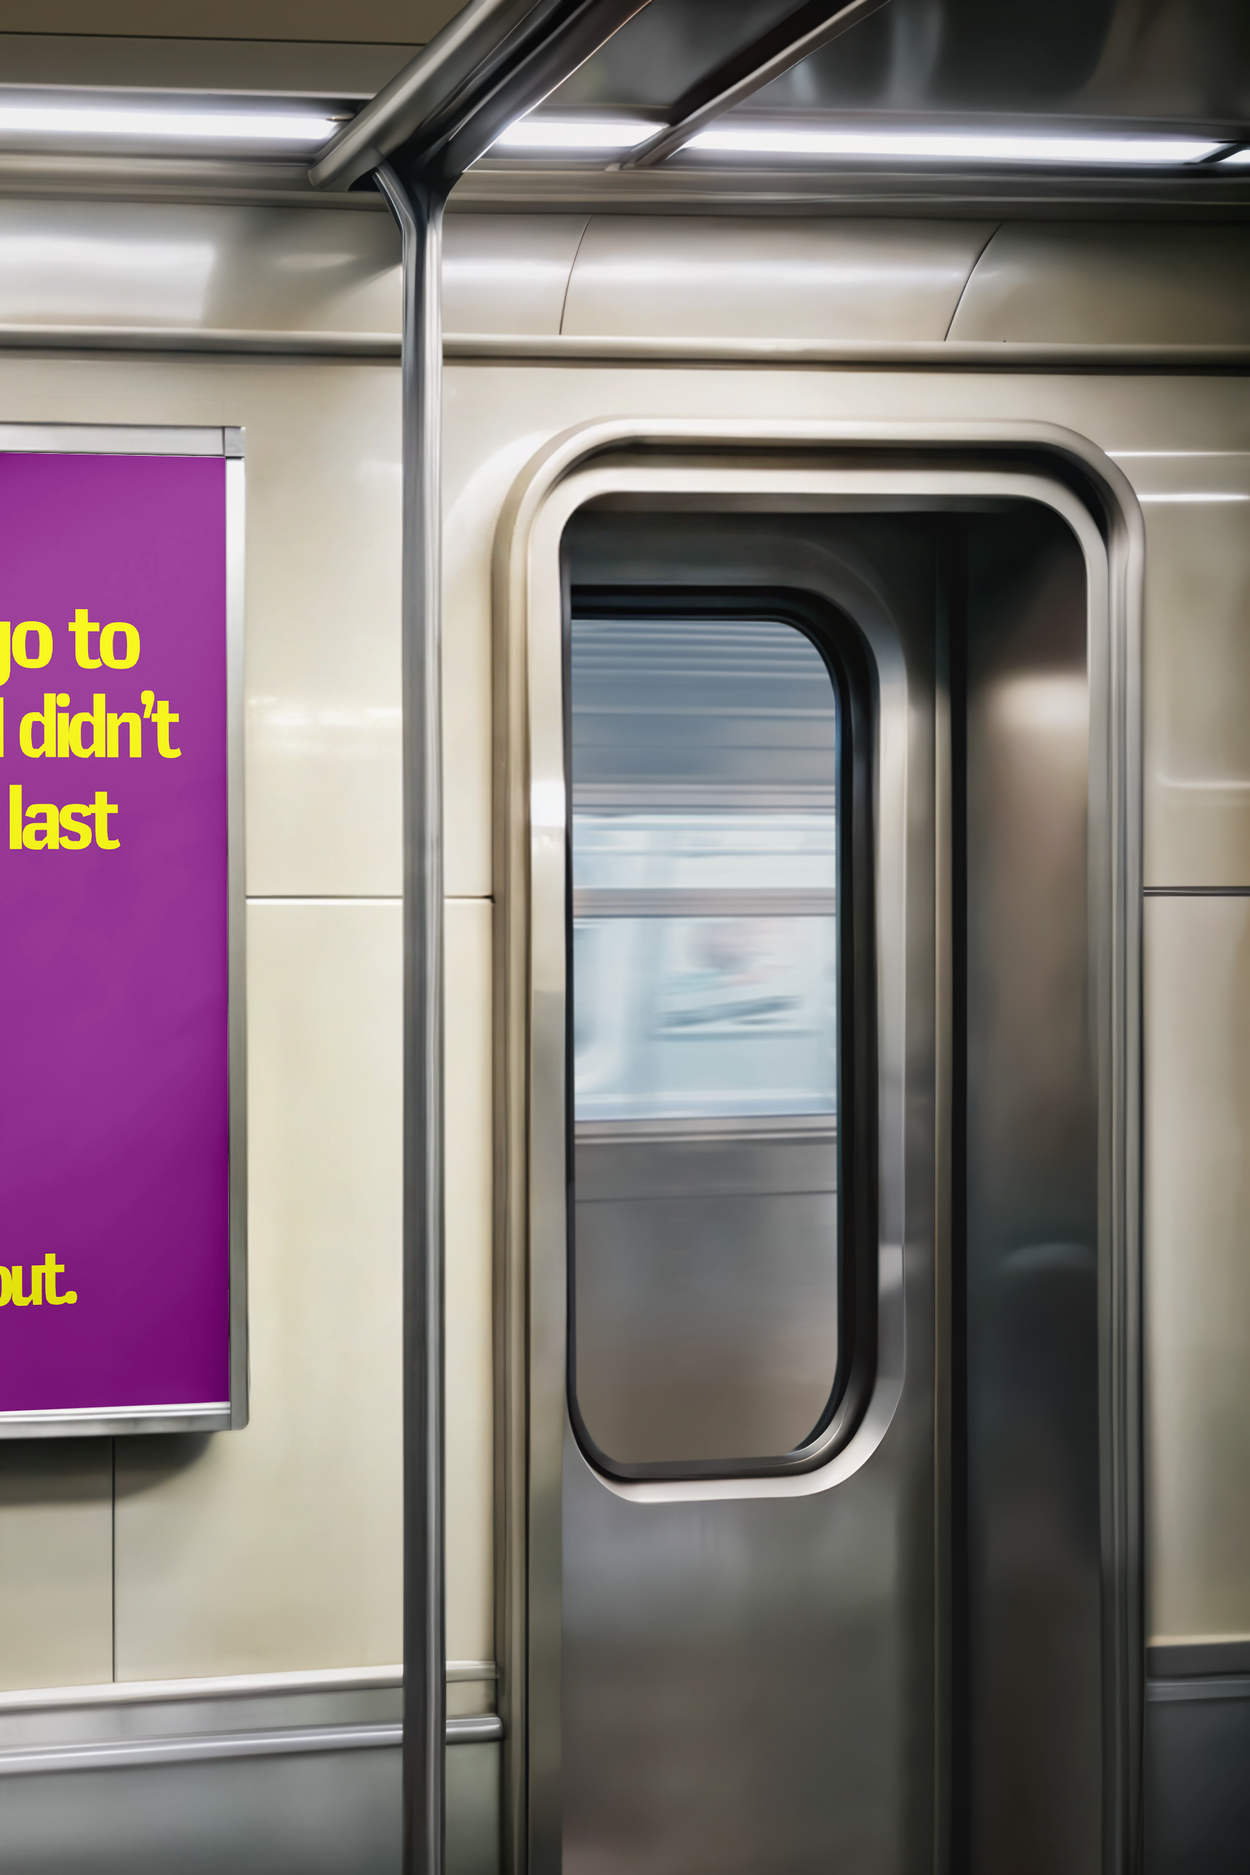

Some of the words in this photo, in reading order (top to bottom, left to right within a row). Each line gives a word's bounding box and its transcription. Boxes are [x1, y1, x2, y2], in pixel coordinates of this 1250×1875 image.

[69, 609, 140, 669] to
[20, 690, 181, 758] didn't
[10, 785, 120, 850] last
